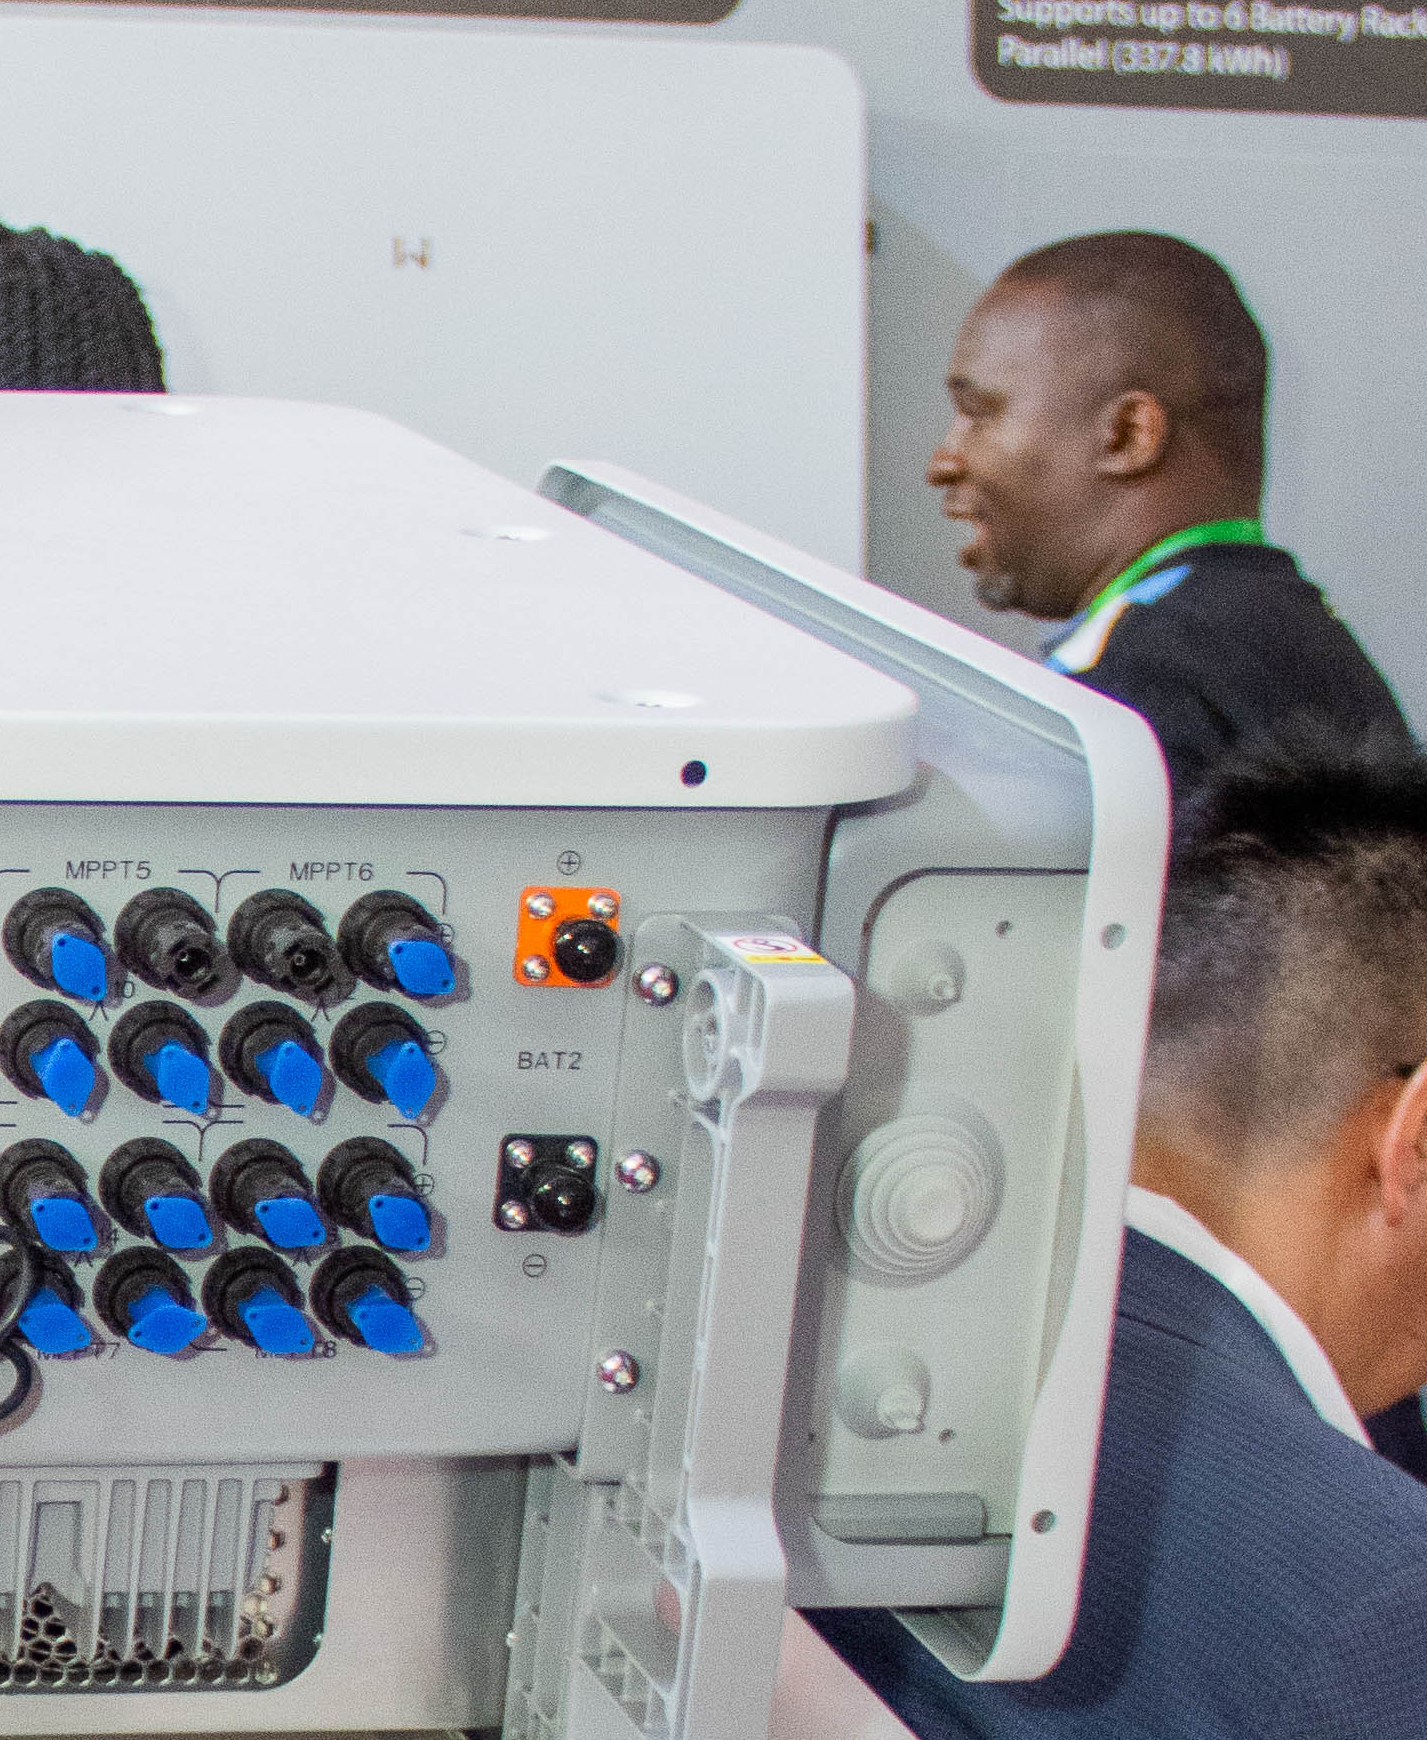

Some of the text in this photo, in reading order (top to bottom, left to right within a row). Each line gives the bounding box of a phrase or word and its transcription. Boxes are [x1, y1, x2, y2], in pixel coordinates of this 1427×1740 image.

[1141, 4, 1185, 32] up
[1187, 1, 1224, 29] to
[1221, 1, 1248, 30] 6
[1246, 0, 1359, 41] Battery
[999, 35, 1108, 69] Parallel
[1209, 45, 1288, 78] kWh)
[66, 859, 152, 880] MPPT5
[290, 861, 374, 882] MPPT6
[517, 1051, 583, 1071] BAT2
